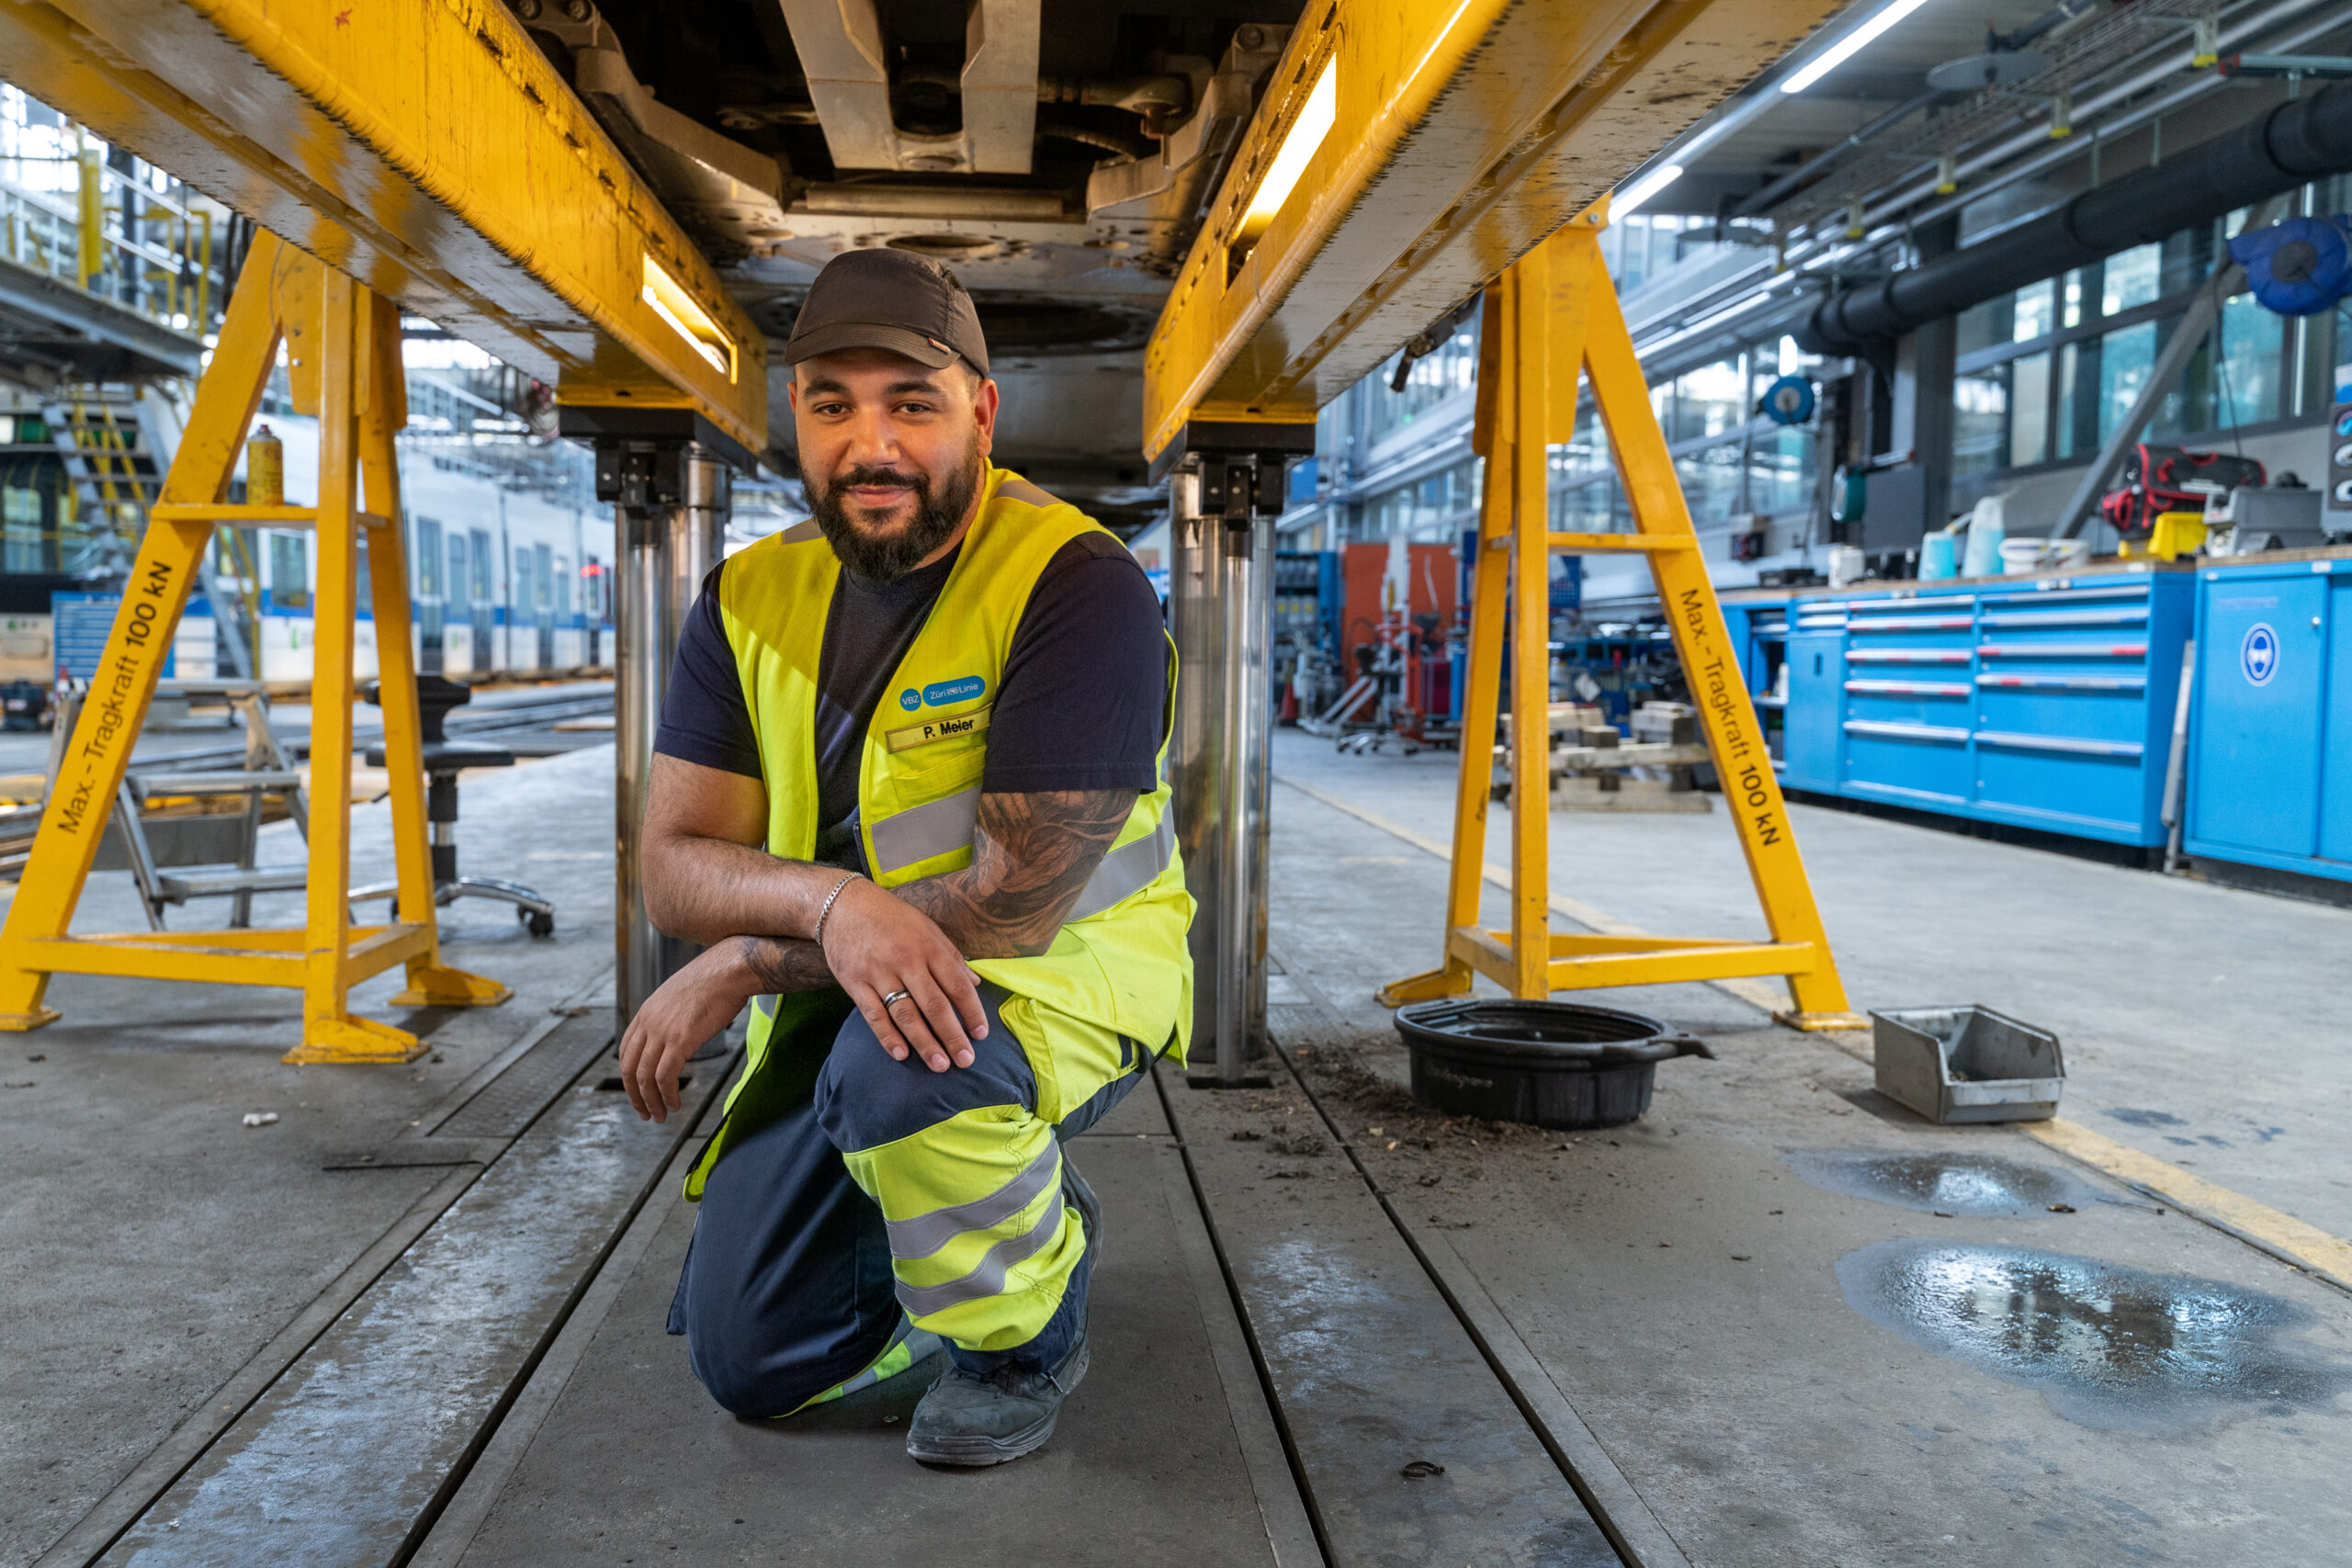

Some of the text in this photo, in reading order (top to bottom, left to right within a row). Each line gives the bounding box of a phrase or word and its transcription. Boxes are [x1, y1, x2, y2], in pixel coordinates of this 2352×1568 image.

[57, 779, 96, 835] Max.
[83, 654, 140, 759] Tragkraft
[125, 602, 157, 648] 100
[142, 560, 173, 599] kN
[901, 694, 920, 706] VBZ
[958, 682, 979, 694] Linie
[923, 719, 975, 739] P. Meier
[1680, 589, 1708, 646] Max.
[1704, 656, 1750, 760] Tragkraft
[1739, 763, 1768, 807] 100
[1755, 812, 1781, 847] kN
